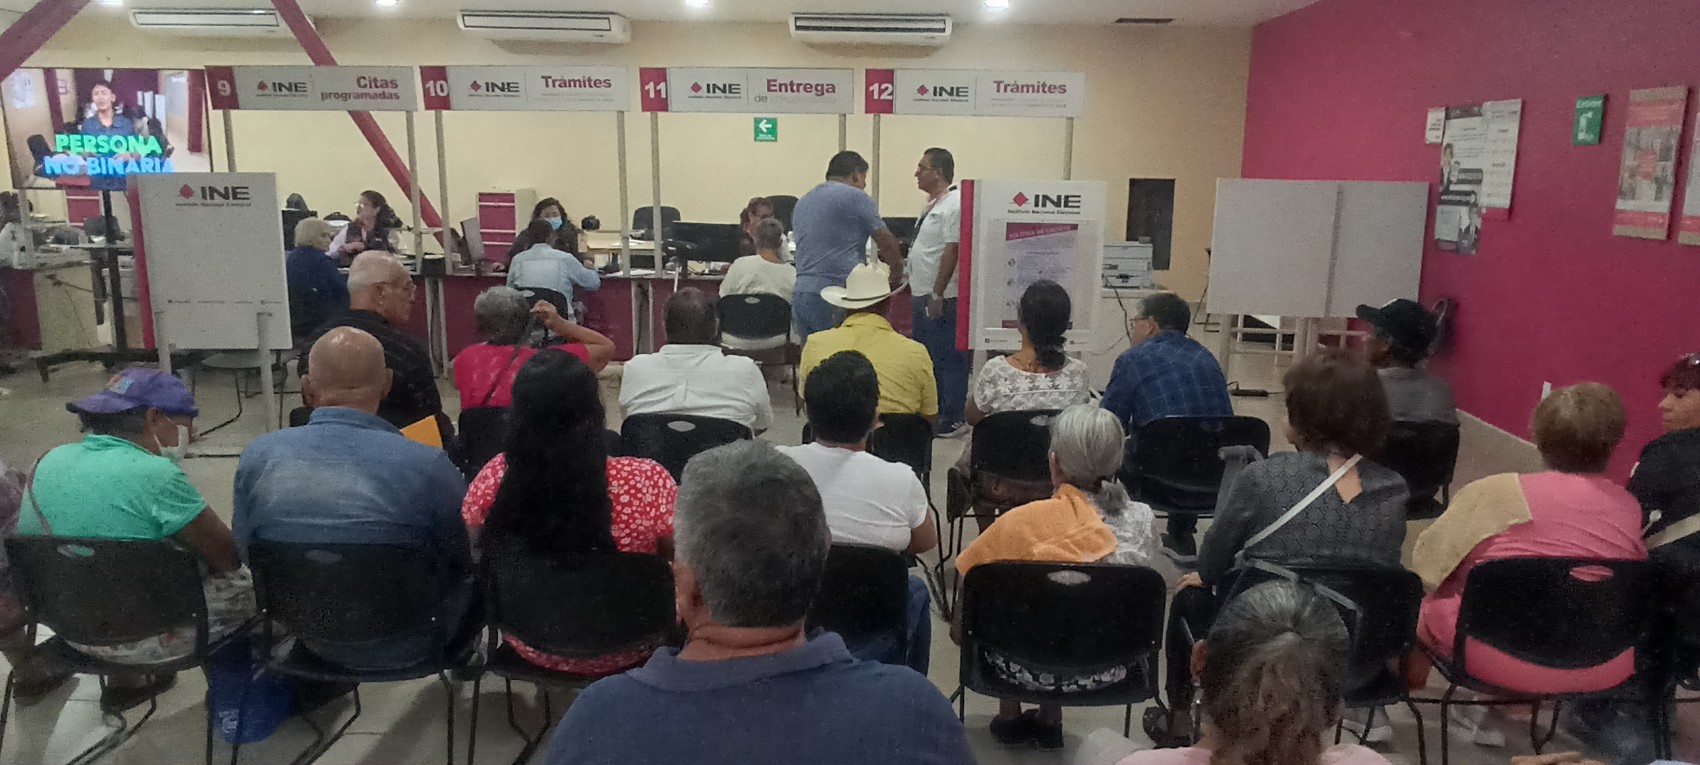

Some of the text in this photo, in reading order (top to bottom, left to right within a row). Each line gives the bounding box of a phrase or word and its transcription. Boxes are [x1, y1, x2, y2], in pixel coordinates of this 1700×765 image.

[218, 80, 232, 97] 9
[272, 81, 308, 93] INE
[356, 75, 399, 90] Citas
[425, 79, 448, 97] 10
[485, 81, 520, 93] INE
[541, 75, 613, 89] Trámites
[644, 81, 667, 98] 11
[705, 83, 742, 95] INE
[766, 78, 836, 97] Entrega
[993, 79, 1068, 95] Trámites
[320, 90, 401, 103] programadas
[754, 94, 768, 104] de
[868, 83, 893, 100] 12
[933, 86, 969, 98] INE
[55, 134, 163, 156] PERSONA
[44, 155, 175, 175] NO BINARIA
[200, 185, 251, 201] INE
[1034, 194, 1081, 208] INE
